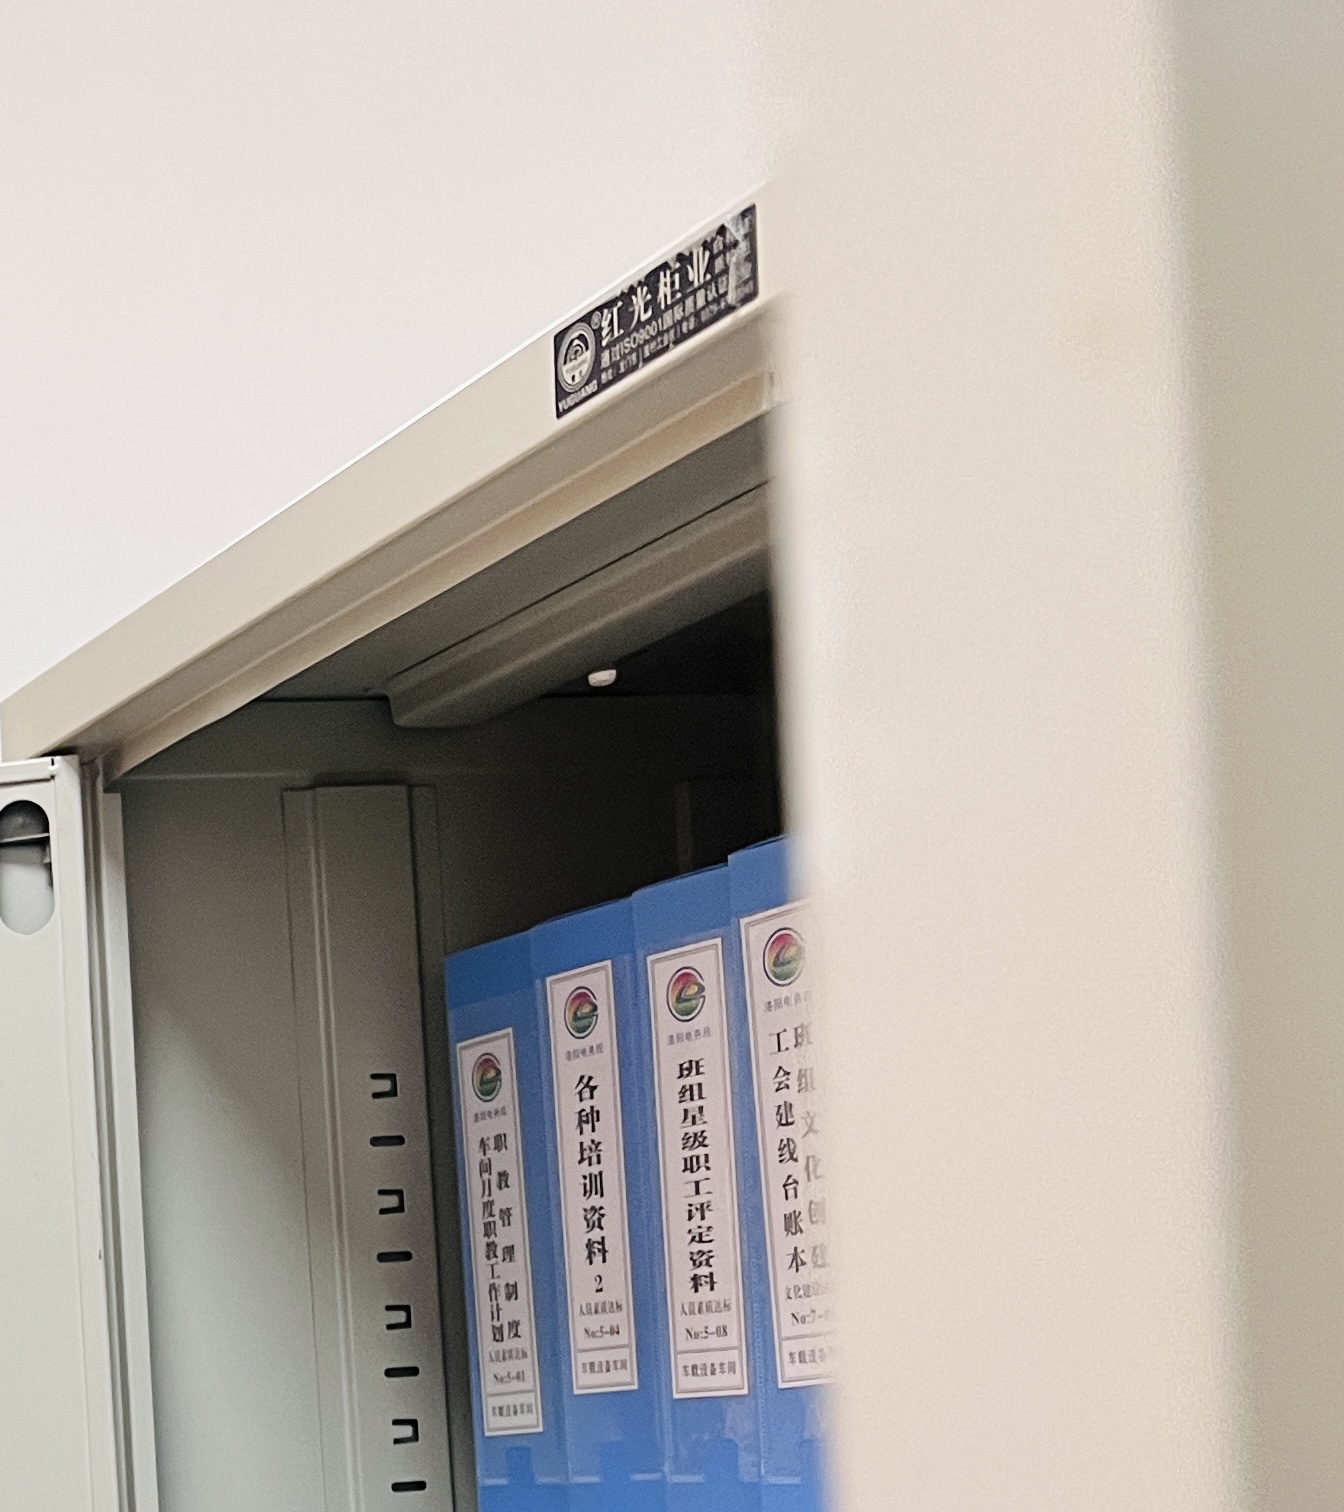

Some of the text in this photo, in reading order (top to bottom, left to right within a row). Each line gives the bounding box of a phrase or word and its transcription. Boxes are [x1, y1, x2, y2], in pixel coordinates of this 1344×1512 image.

[600, 247, 712, 346] 红光柜业
[478, 1136, 505, 1343] 车间月度职教工作计划
[493, 1132, 522, 1340] 职教管理制度
[573, 1074, 609, 1293] 各种培训资料 2
[676, 1058, 718, 1294] 班组星级职工评定资料
[769, 1028, 807, 1274] 工会建线台账本
